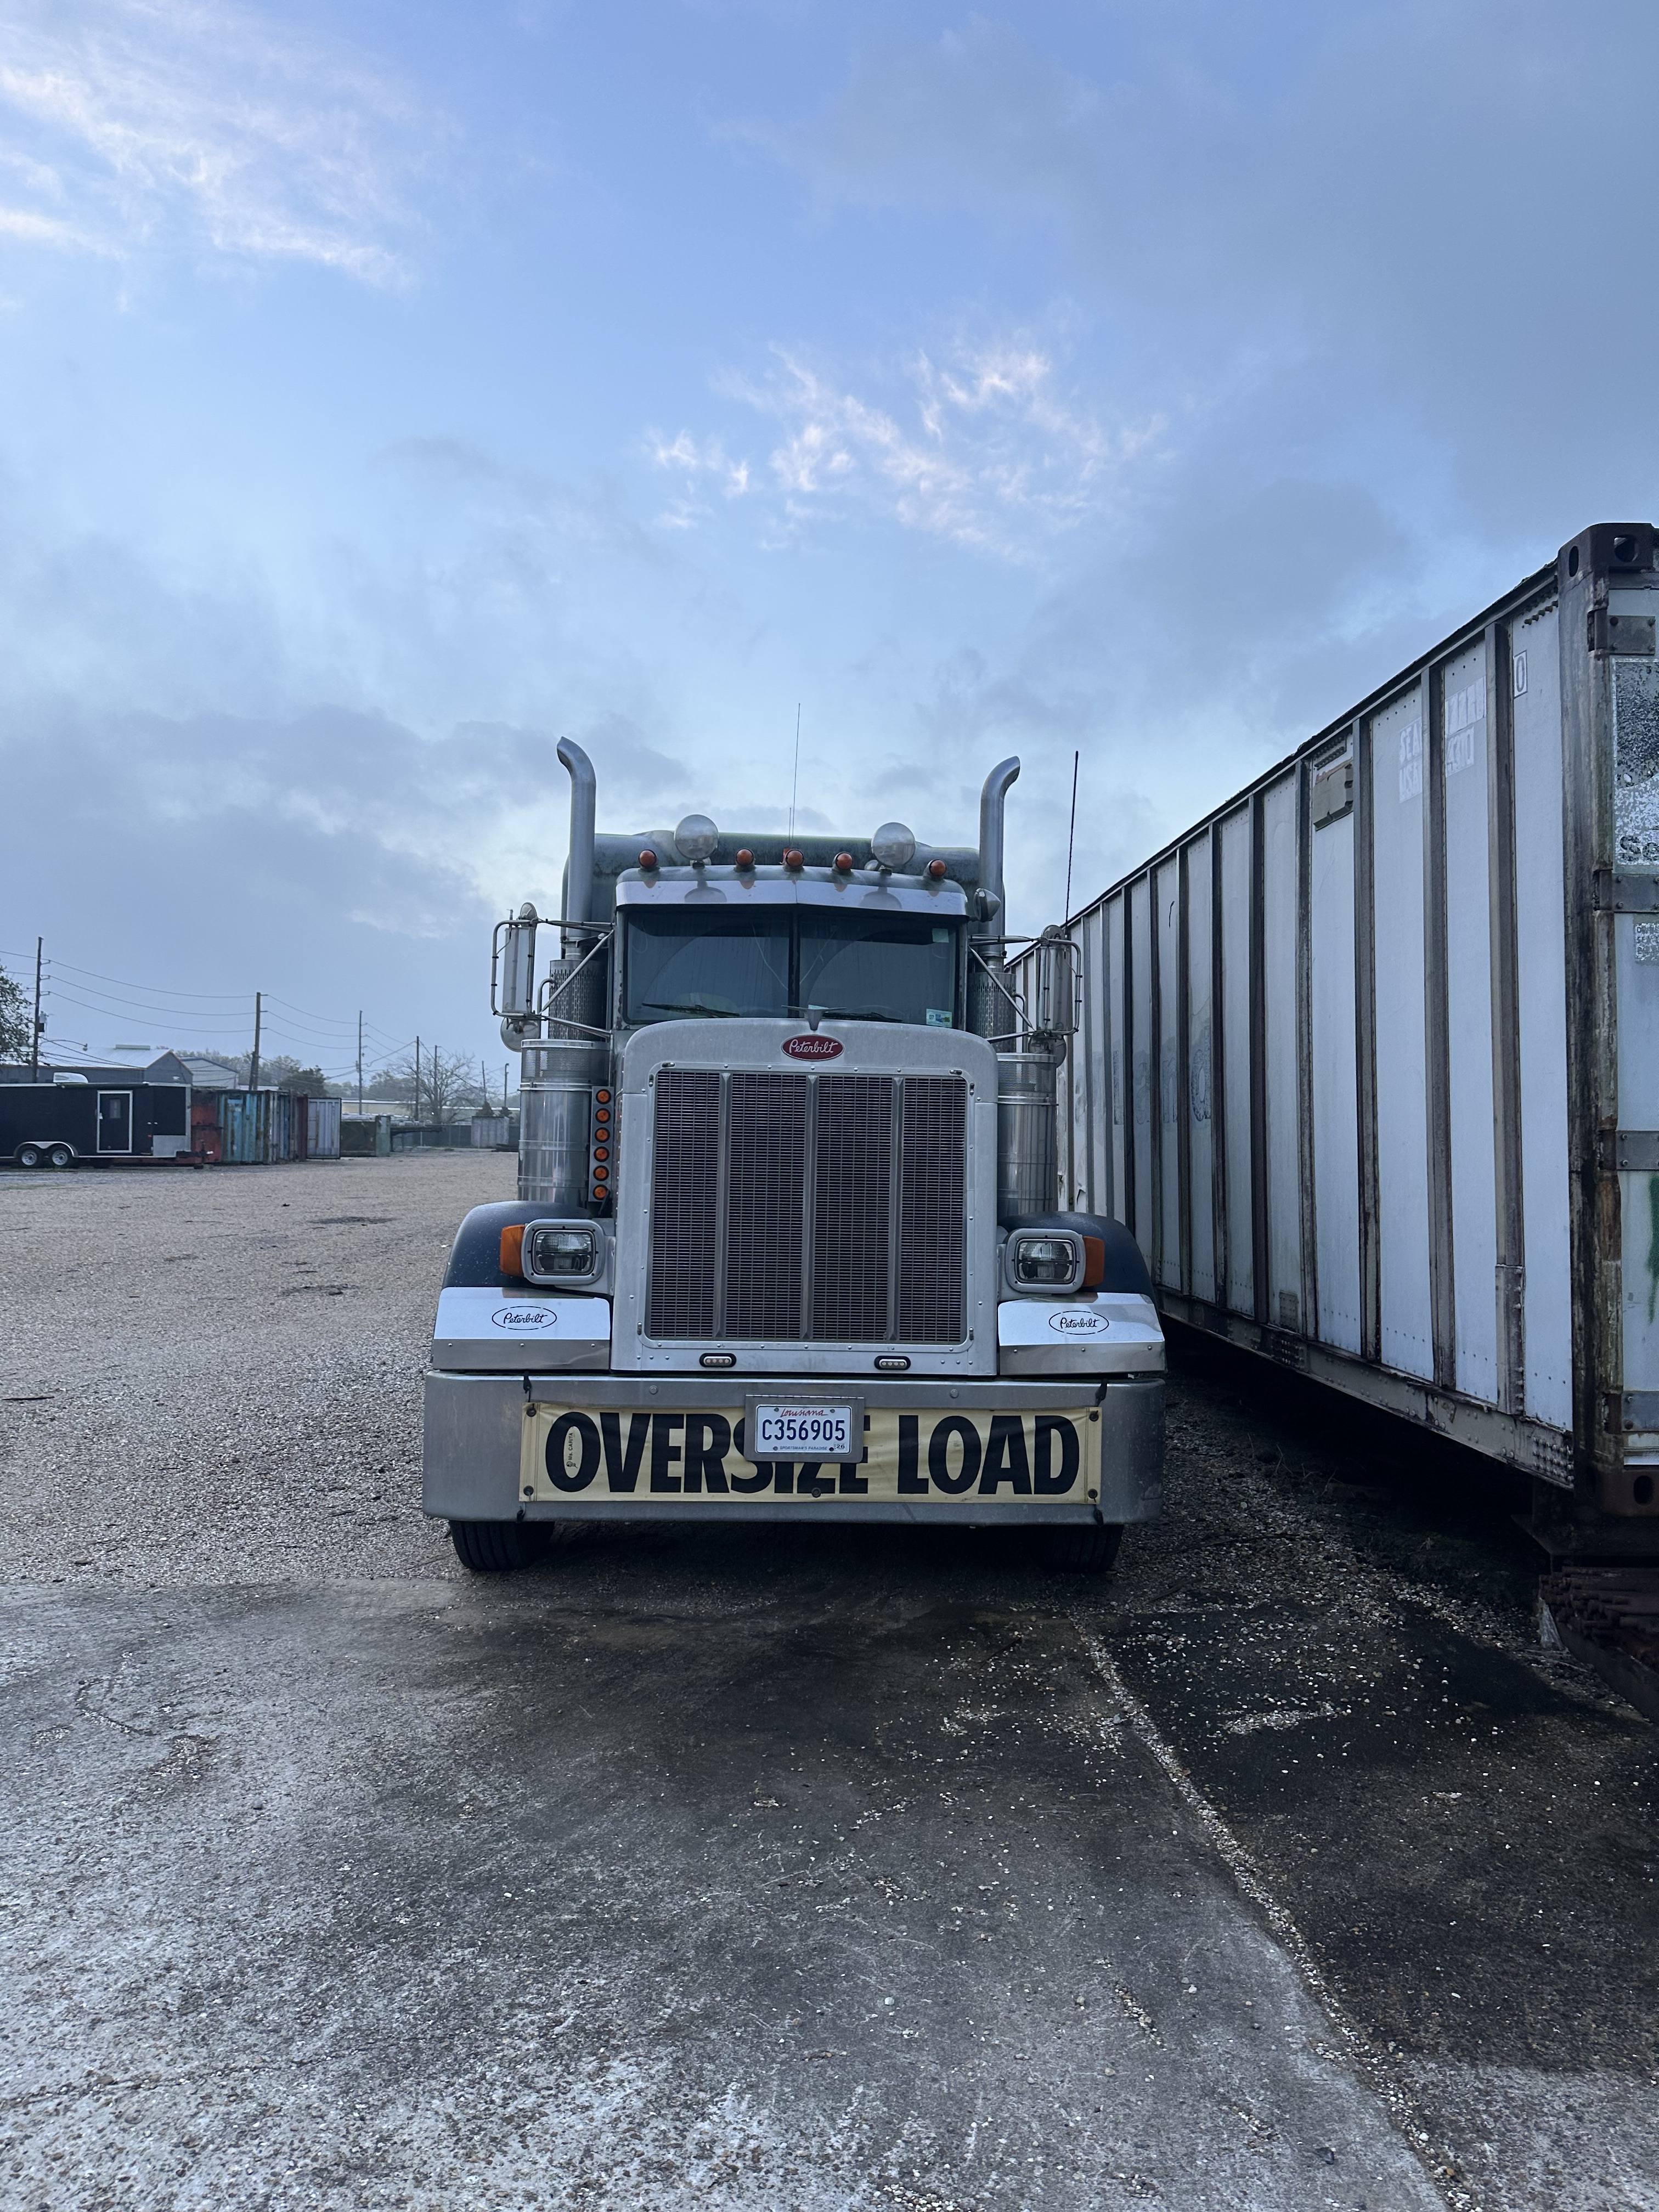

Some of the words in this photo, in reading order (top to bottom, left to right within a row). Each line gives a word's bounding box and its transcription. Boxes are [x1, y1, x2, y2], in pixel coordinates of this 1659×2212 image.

[789, 1039, 838, 1053] Peterbilt
[504, 1313, 548, 1324] Peterbilt
[1060, 1318, 1099, 1329] Peterbilt
[780, 1408, 828, 1418] Louisiana
[762, 1419, 845, 1441] C356905
[898, 1415, 1080, 1495] LOAD
